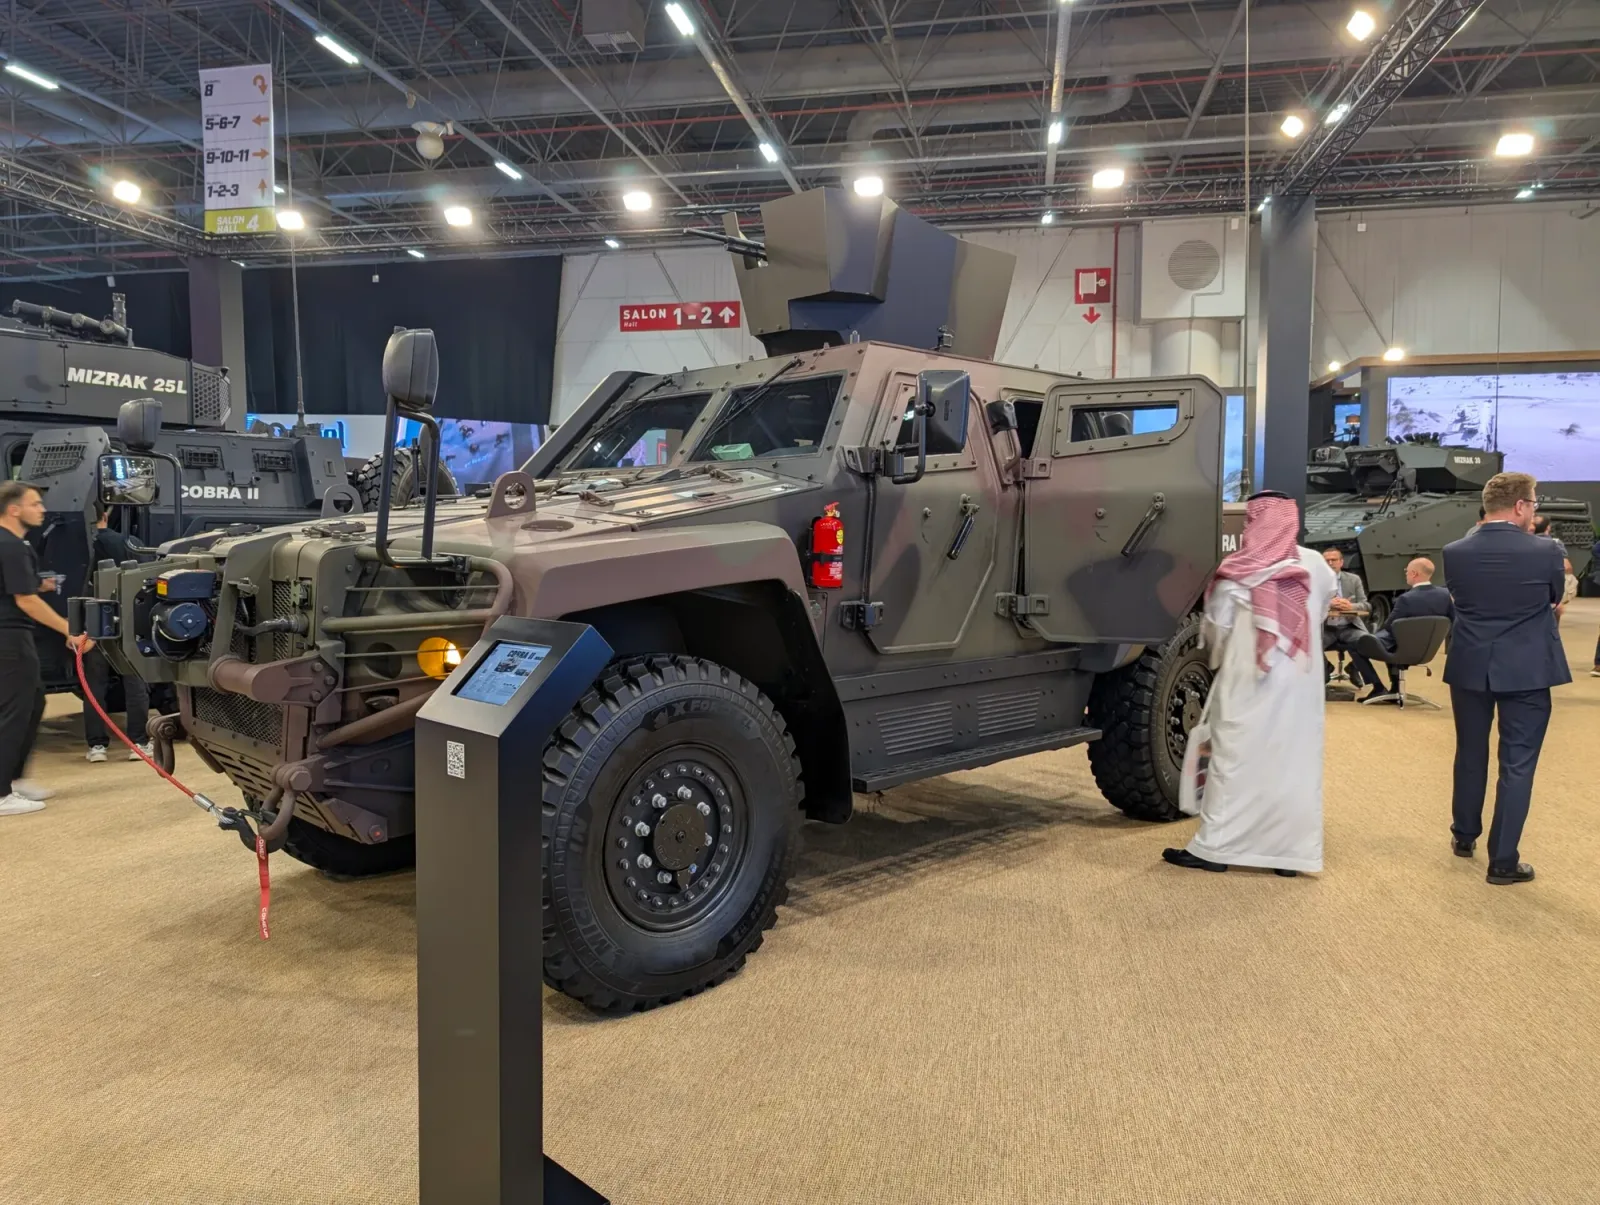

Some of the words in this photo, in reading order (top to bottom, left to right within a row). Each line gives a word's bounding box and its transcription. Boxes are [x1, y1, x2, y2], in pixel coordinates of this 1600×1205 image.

[204, 84, 214, 97] 8
[205, 115, 241, 131] 5-6-7
[206, 149, 250, 164] 9-10-11
[207, 184, 239, 198] 1-2-3
[216, 224, 239, 234] HALL
[217, 215, 245, 225] SALON
[246, 214, 259, 232] 4
[623, 308, 667, 320] SALON
[67, 367, 148, 390] MIZRAK
[152, 378, 188, 395] 25L
[181, 484, 242, 500] COBRA
[247, 487, 259, 499] II
